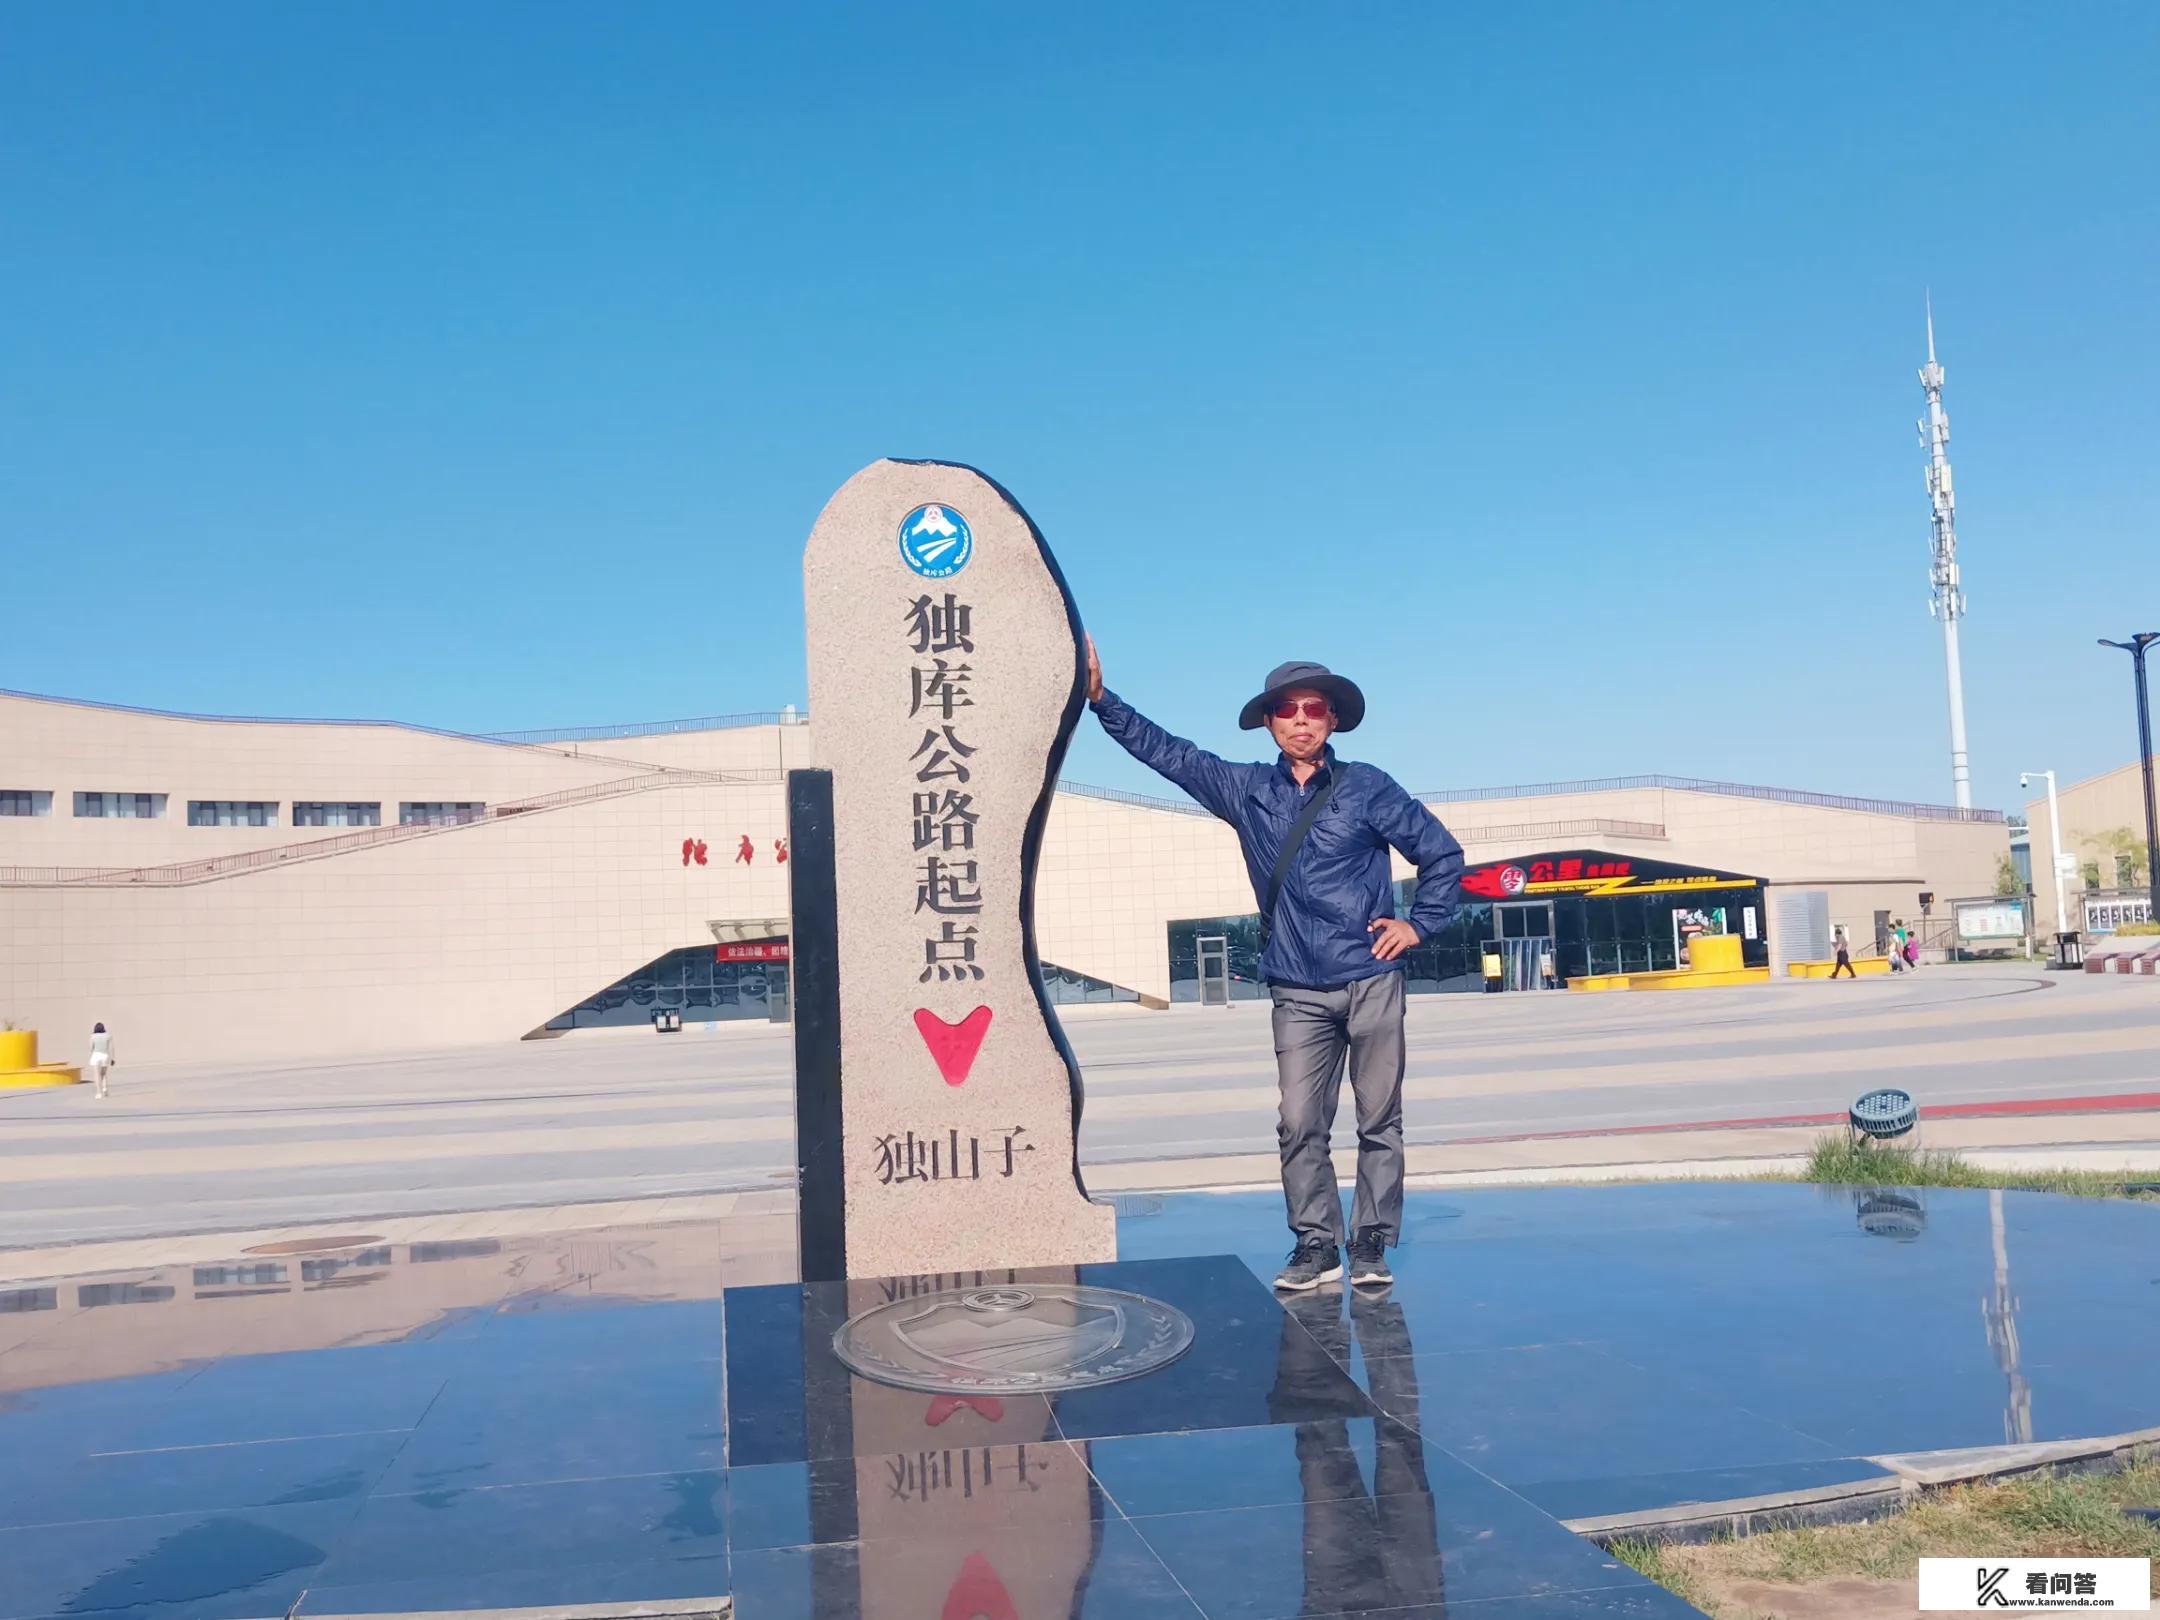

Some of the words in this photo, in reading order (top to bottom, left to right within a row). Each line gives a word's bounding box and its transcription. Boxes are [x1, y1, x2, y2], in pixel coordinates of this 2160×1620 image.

[903, 593, 984, 983] 独库公路起点
[874, 1126, 1036, 1185] 独山子
